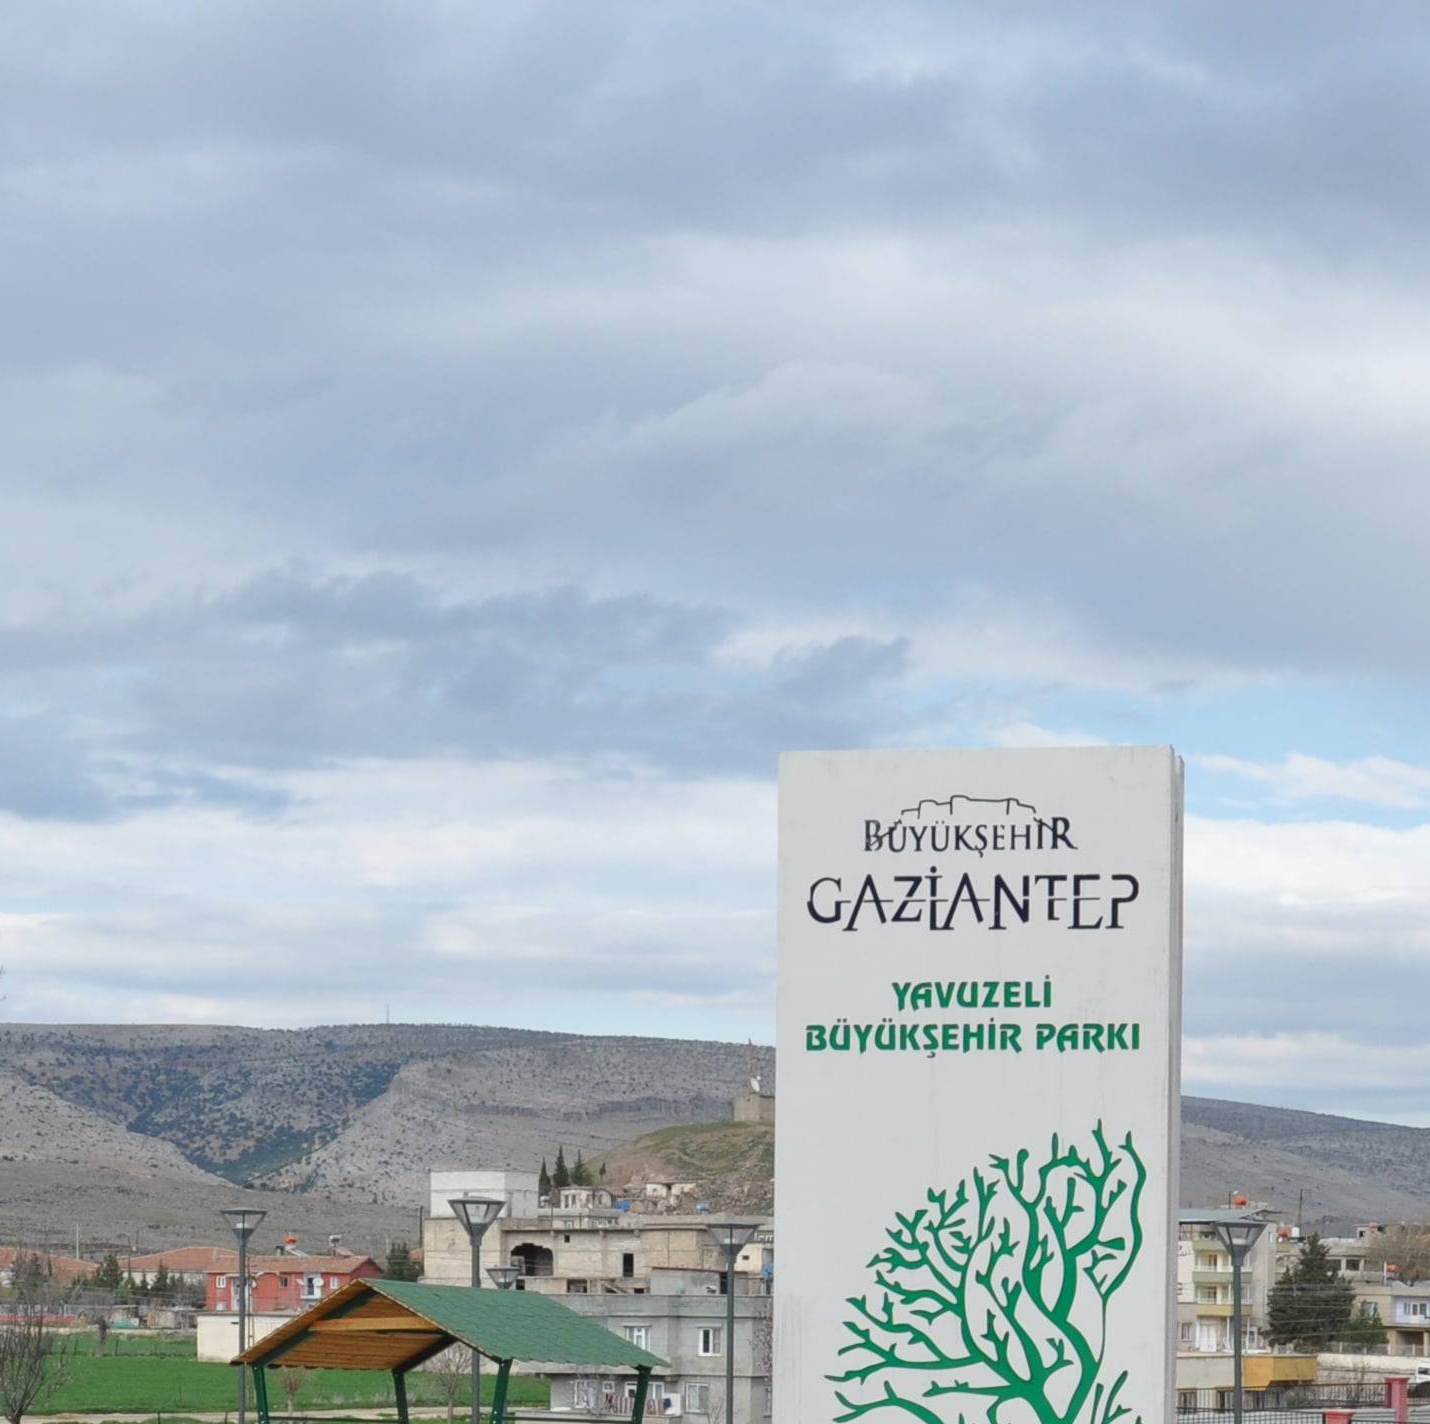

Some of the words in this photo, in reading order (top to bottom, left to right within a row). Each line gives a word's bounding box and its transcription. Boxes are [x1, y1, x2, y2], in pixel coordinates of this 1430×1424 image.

[865, 815, 1078, 858] BÜYÜKŞEHİR
[807, 866, 1139, 931] GAZİANTEP
[892, 975, 1052, 1011] YAVUZELİ
[806, 1018, 1022, 1058] BÜYÜKŞEHİR
[1036, 1023, 1140, 1053] PARKI
